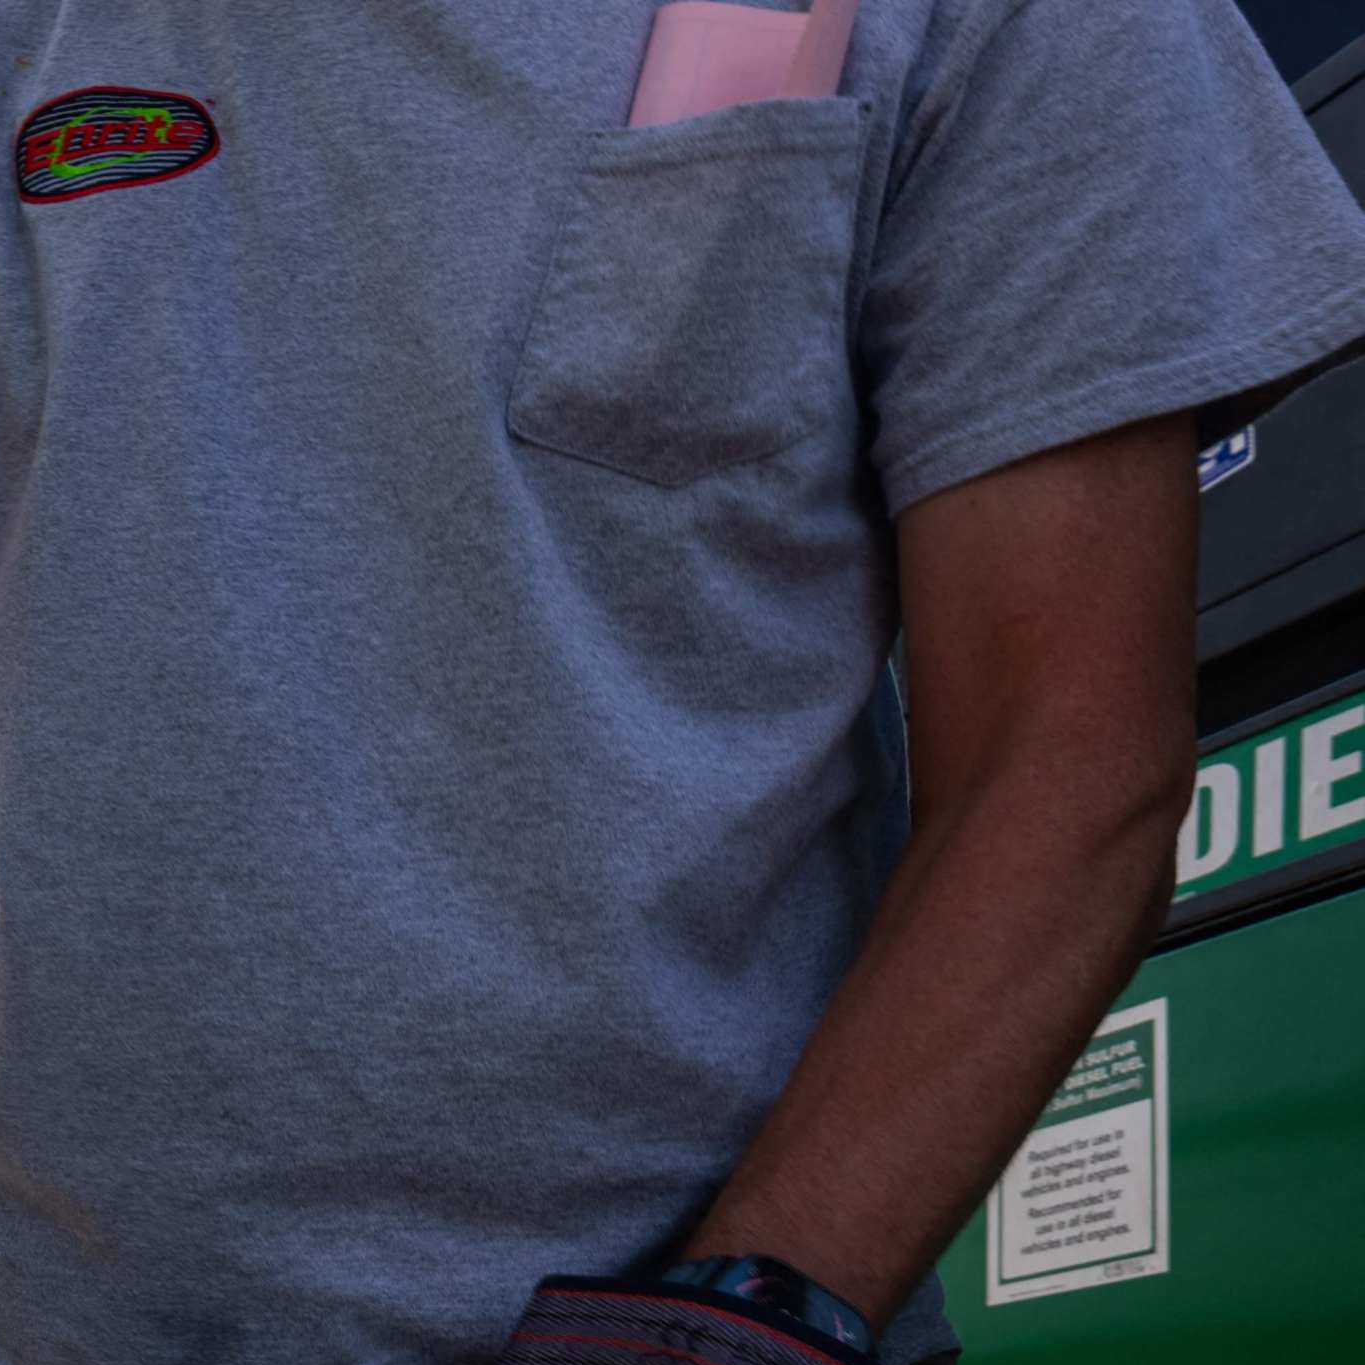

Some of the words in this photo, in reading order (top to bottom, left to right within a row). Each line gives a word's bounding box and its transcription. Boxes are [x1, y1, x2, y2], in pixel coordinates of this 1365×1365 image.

[1175, 704, 1365, 885] DIE
[1086, 1039, 1137, 1067] SULFUR
[1111, 1055, 1146, 1076] FUEL
[1027, 1141, 1073, 1163] Required
[1075, 1137, 1089, 1152] for
[1092, 1133, 1111, 1147] use
[1089, 1147, 1122, 1165] diesel
[1020, 1181, 1063, 1199] vehicles
[1064, 1174, 1084, 1189] and
[1027, 1192, 1105, 1218] Recommended
[1107, 1188, 1123, 1202] for
[1035, 1222, 1054, 1236] use
[1084, 1206, 1116, 1225] diesel
[1020, 1237, 1063, 1255] vehicles
[1064, 1231, 1084, 1247] and
